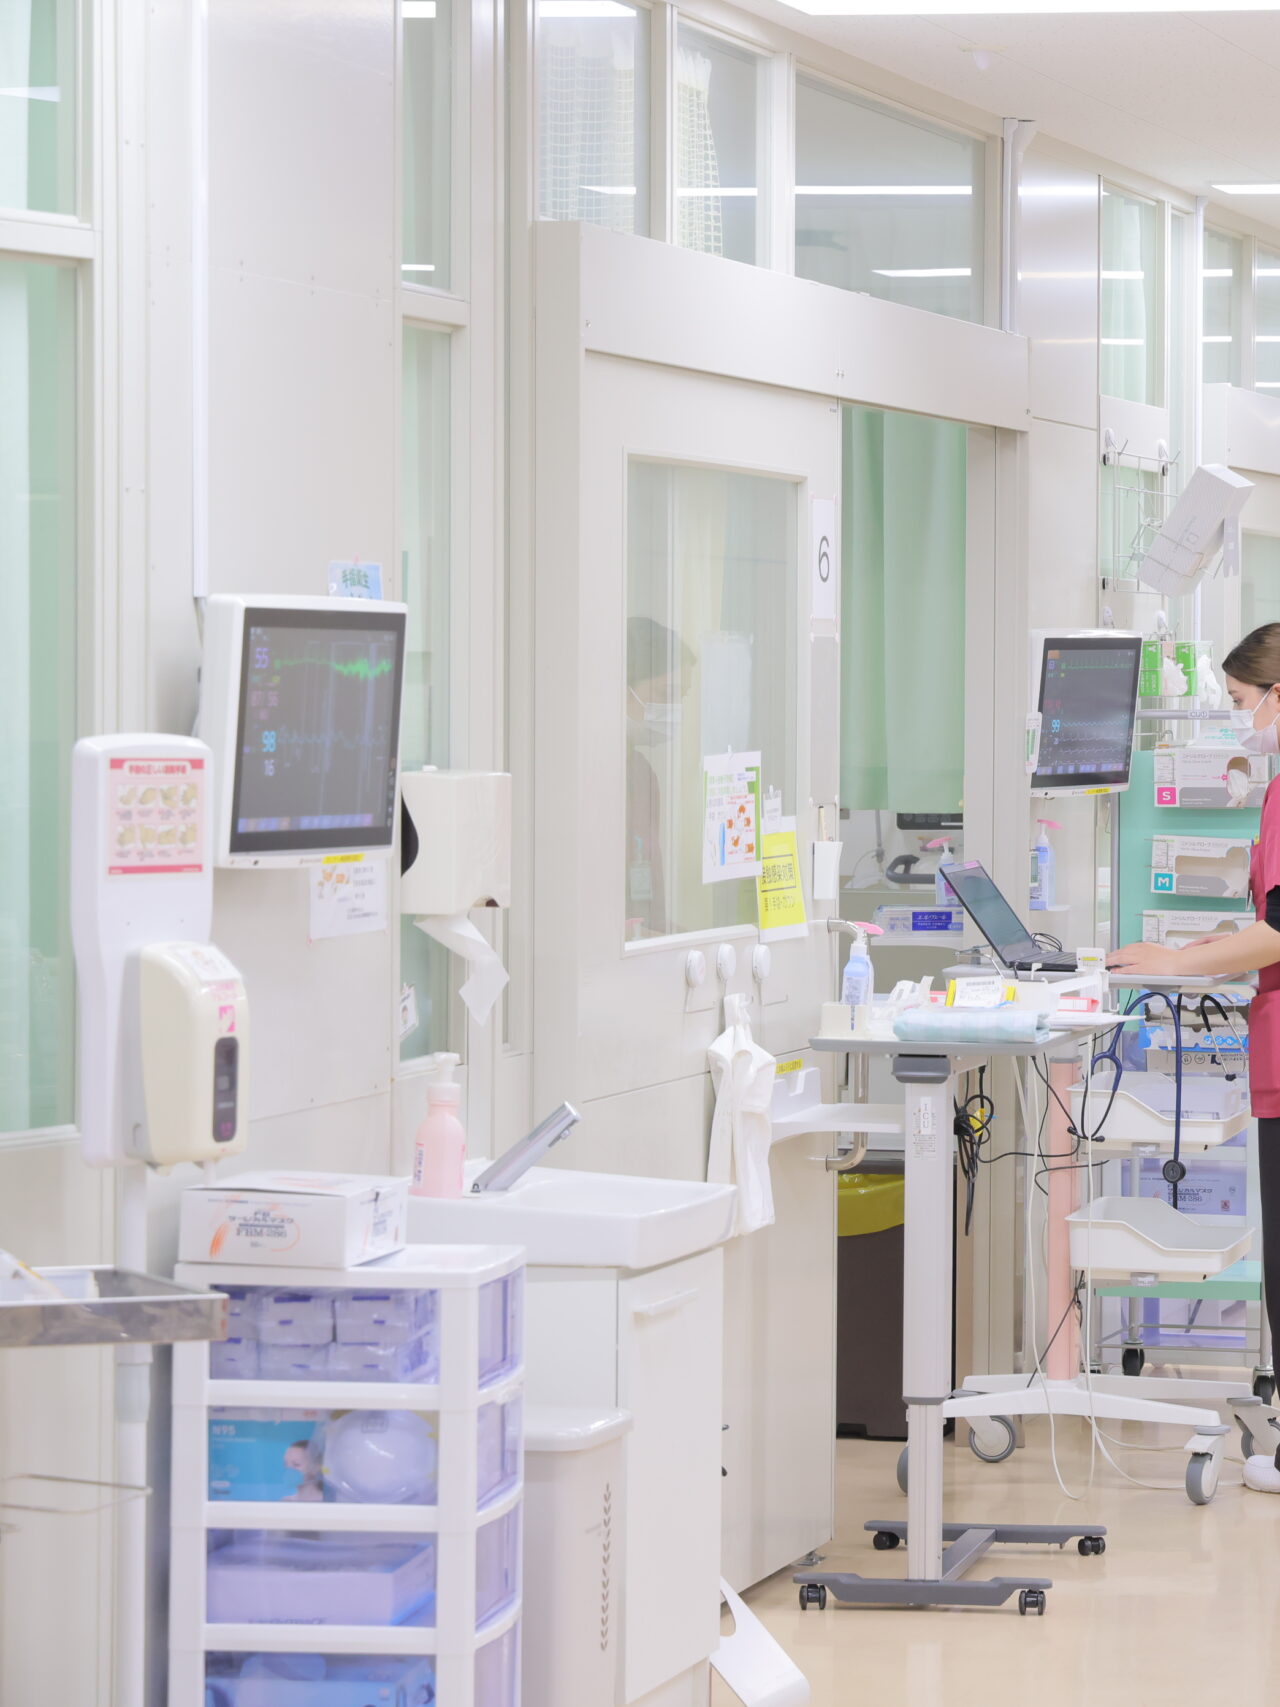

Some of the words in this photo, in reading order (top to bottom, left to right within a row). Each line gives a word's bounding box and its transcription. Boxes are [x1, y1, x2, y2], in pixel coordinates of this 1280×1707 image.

[818, 535, 830, 583] 6
[262, 730, 277, 752] 98
[1162, 791, 1172, 801] S
[1157, 877, 1170, 887] M
[922, 1103, 930, 1129] ICU
[212, 1424, 236, 1436] N95
